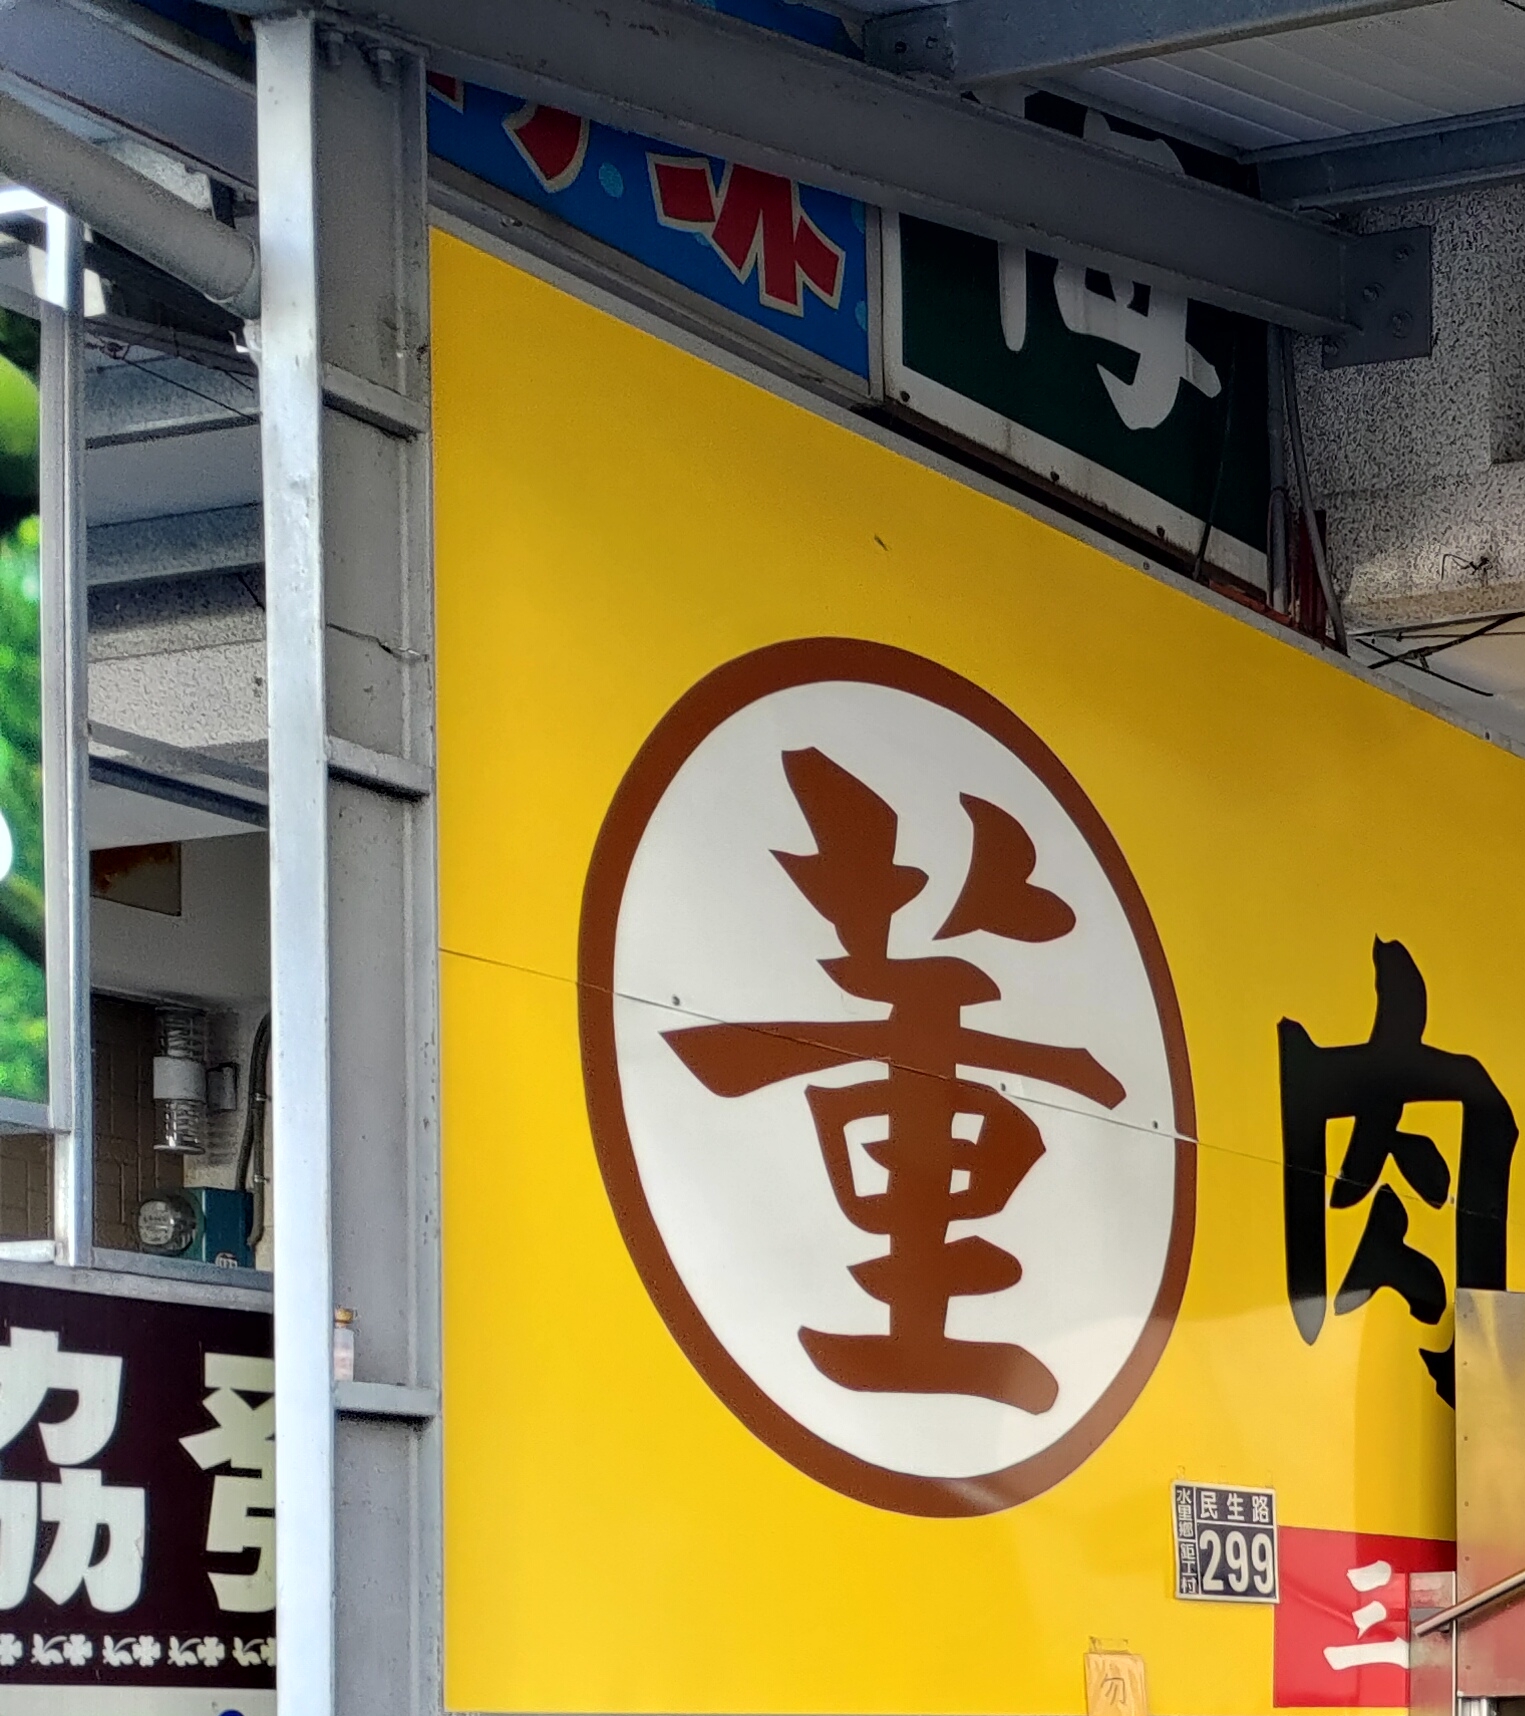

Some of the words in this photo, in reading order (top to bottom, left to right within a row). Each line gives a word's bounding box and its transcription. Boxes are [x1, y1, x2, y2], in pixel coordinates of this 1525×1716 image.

[1176, 1488, 1193, 1538] 水里鄉
[1200, 1490, 1270, 1523] 民生路
[1180, 1543, 1198, 1594] 鉅工村
[1199, 1529, 1275, 1594] 299
